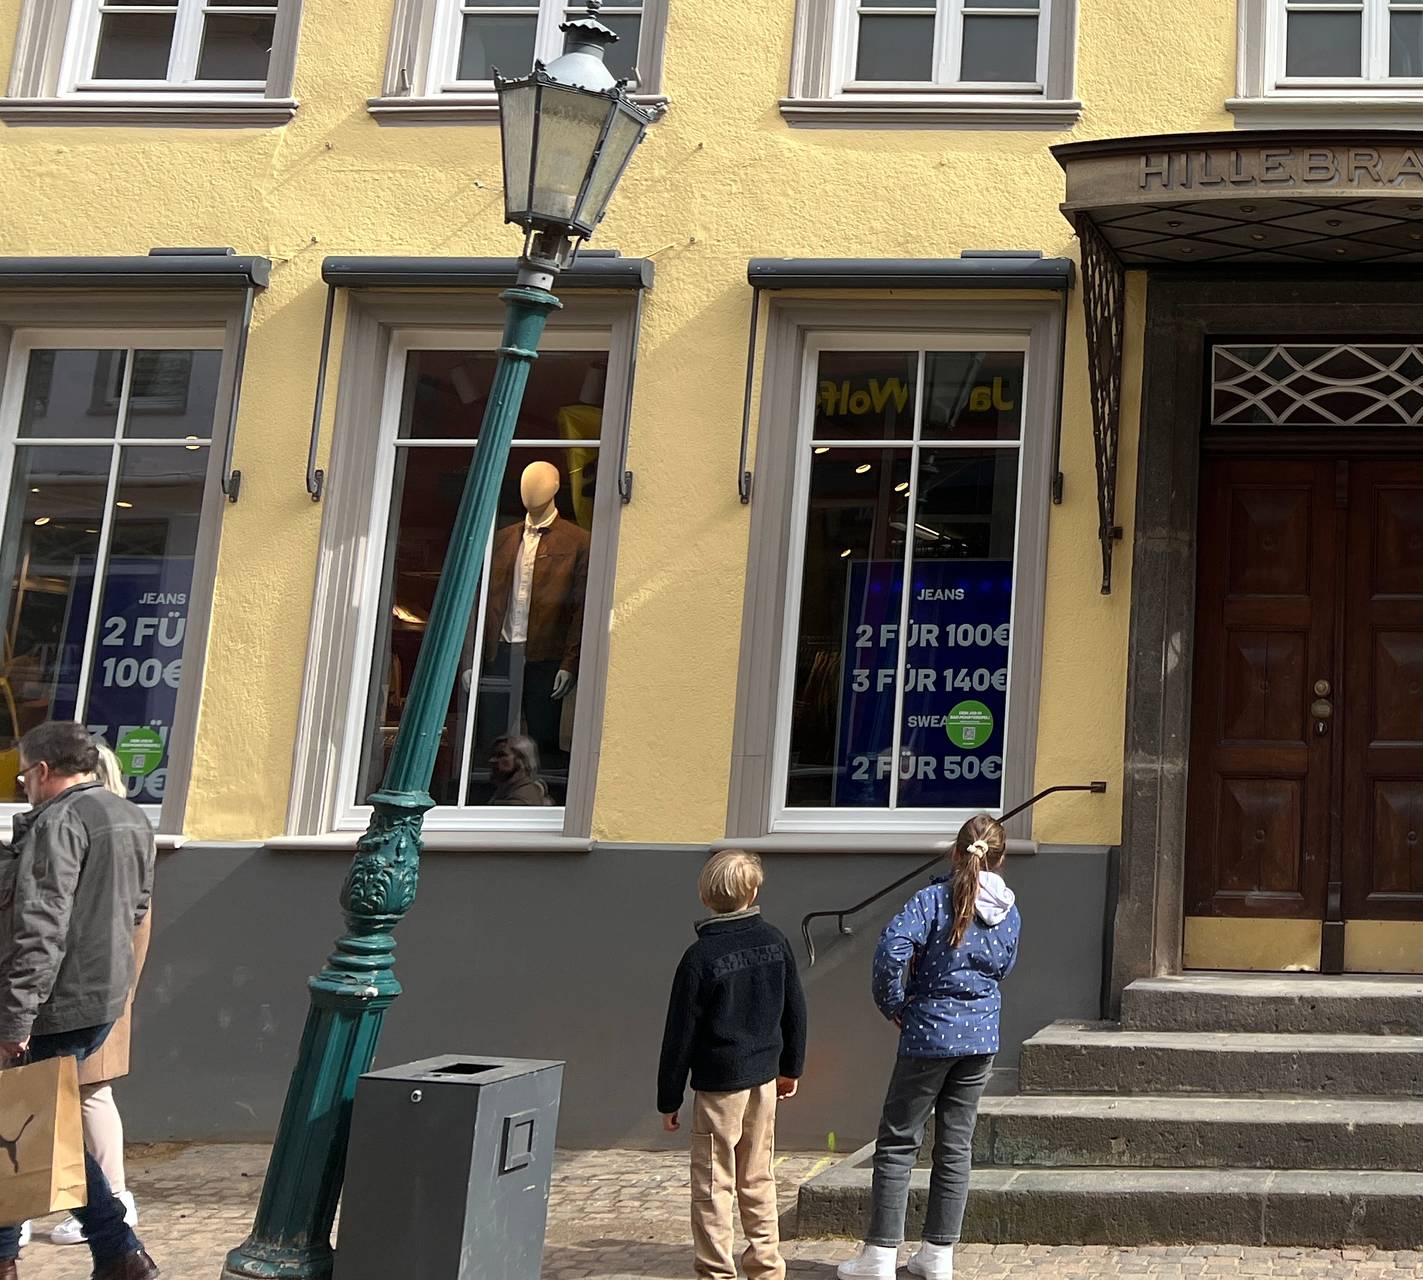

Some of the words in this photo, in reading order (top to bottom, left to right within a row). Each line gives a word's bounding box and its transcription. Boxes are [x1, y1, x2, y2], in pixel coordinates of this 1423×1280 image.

[139, 592, 187, 605] JEANS
[917, 588, 965, 601] JEANS
[102, 616, 127, 646] 2
[855, 624, 873, 648] 2
[945, 623, 1011, 647] 100€
[102, 657, 183, 689] 100€
[851, 668, 870, 692] 3
[943, 667, 1007, 692] 140€
[851, 756, 870, 780] 2
[876, 750, 937, 780] FÜR
[943, 756, 1003, 780] 50€
